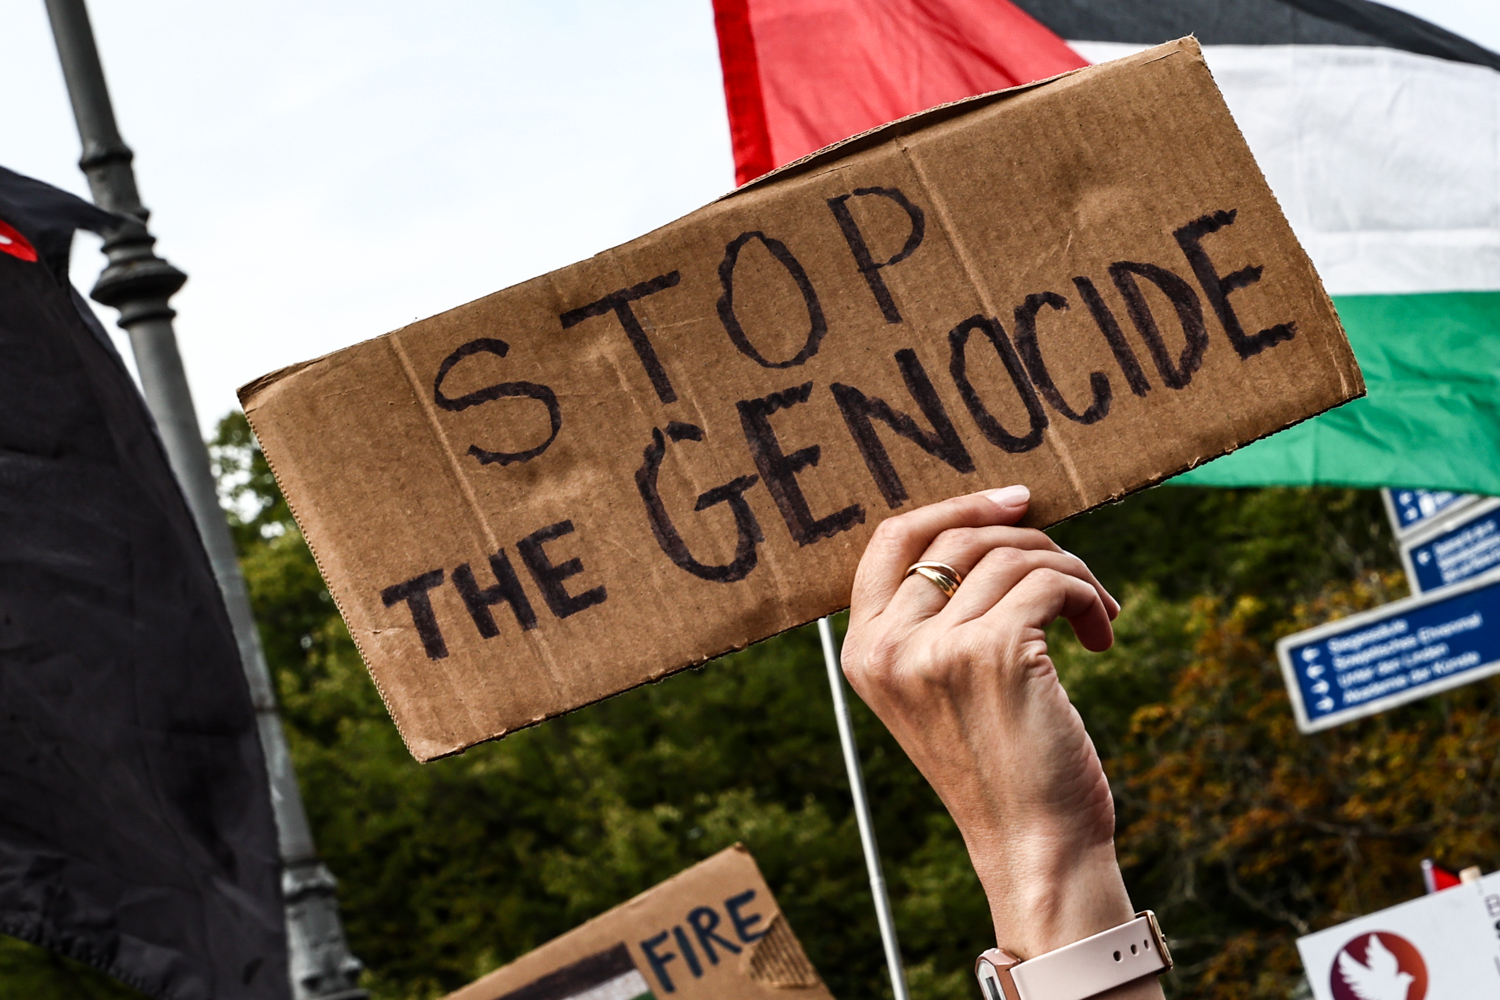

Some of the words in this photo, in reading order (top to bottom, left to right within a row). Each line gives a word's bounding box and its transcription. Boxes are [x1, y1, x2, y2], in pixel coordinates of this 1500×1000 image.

[380, 518, 608, 660] THE
[635, 208, 1298, 583] GENOCIDE
[432, 184, 926, 467] STOP
[640, 889, 768, 994] FIRE
